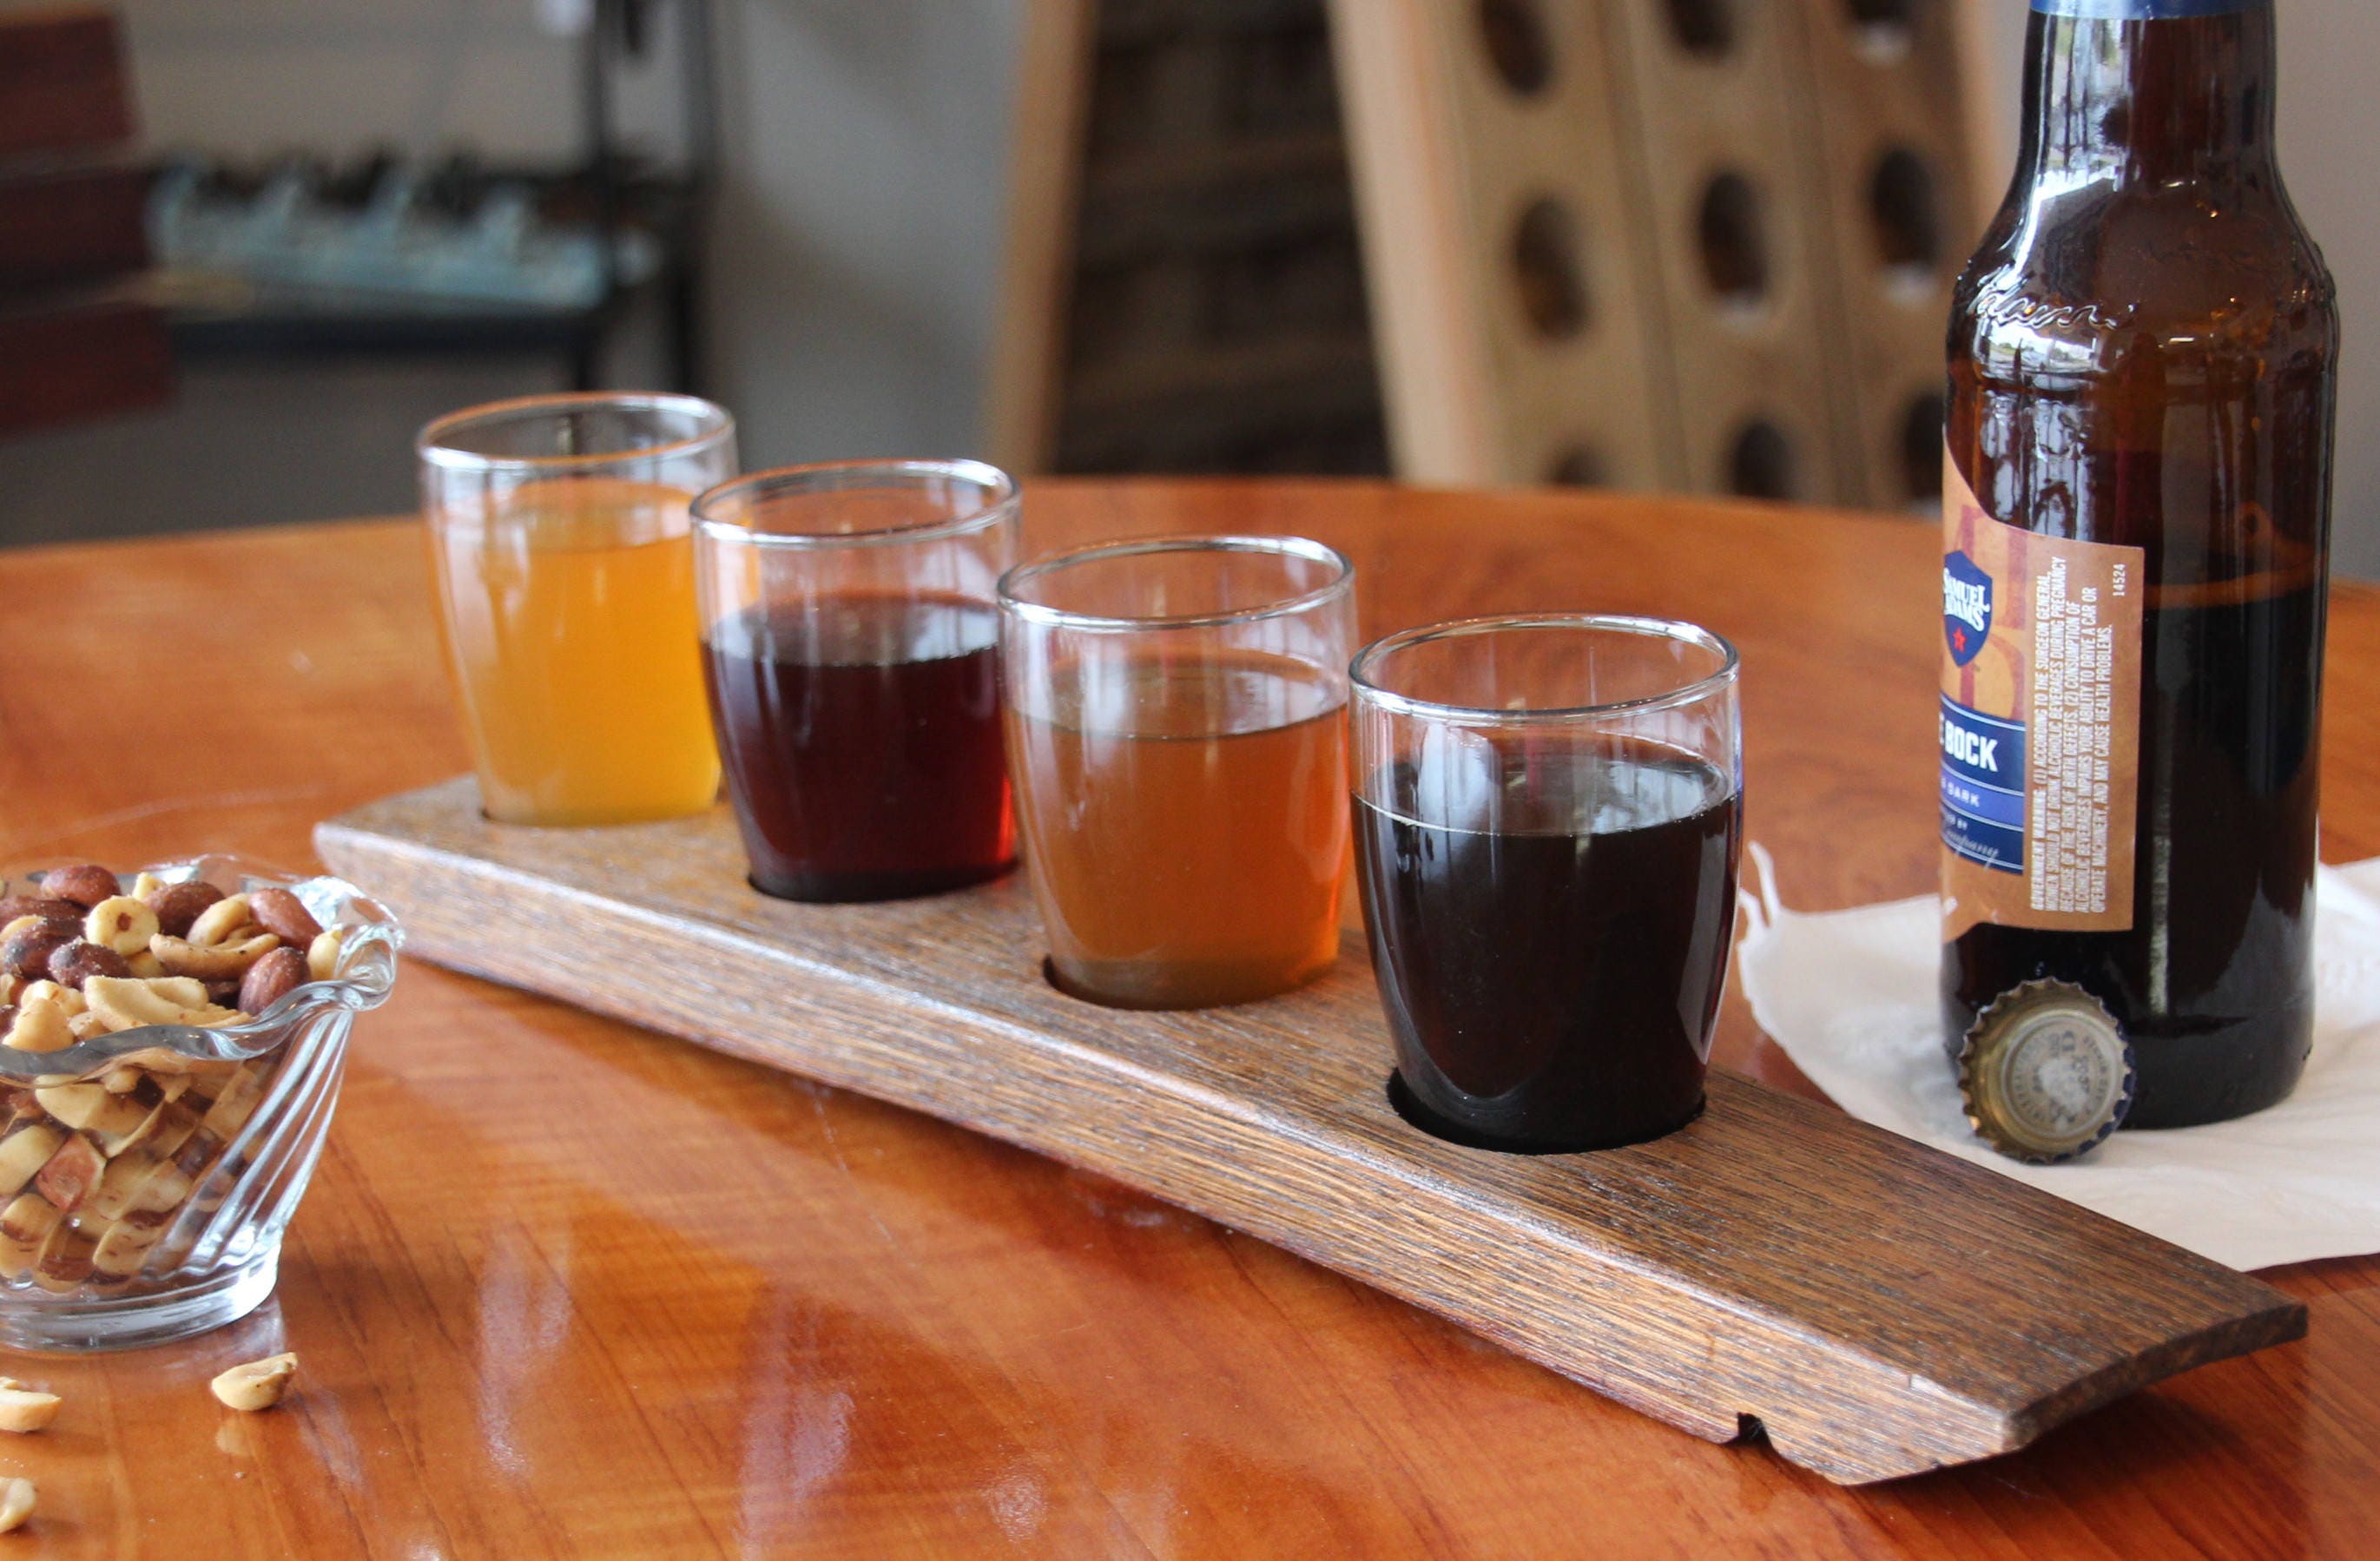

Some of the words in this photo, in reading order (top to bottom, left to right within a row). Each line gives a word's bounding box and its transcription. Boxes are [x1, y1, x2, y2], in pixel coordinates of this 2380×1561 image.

[2051, 557, 2067, 618] PREGNANCY
[2113, 563, 2126, 596] 14524
[2067, 601, 2080, 615] OF
[2082, 587, 2098, 603] OR
[2081, 605, 2097, 626] CAR
[2035, 622, 2050, 669] SURGEON
[2050, 620, 2064, 659] DURING
[2066, 616, 2080, 689] CONSUMPTION
[2080, 638, 2095, 669] DRIVE
[2035, 672, 2048, 690] THE
[2049, 661, 2063, 720] BEVERAGES
[2080, 671, 2094, 683] TO
[2034, 693, 2047, 706] TO
[2066, 691, 2078, 707] (2)
[2080, 686, 2094, 724] ABILITY
[2096, 683, 2111, 721] HEALTH
[1944, 720, 1998, 773] BOCK
[2034, 708, 2048, 767] ACCORDING
[2047, 721, 2062, 778] ALCOHOLIC
[2078, 725, 2093, 753] YOUR
[2094, 724, 2110, 757] CAUSE
[2063, 757, 2077, 787] BIRTH
[2077, 755, 2092, 796] IMPAIRS
[2094, 760, 2108, 781] MAY
[1948, 780, 1980, 807] DARK
[2047, 779, 2060, 809] DRINK
[2062, 789, 2076, 803] OF
[2093, 783, 2108, 804] AND
[2047, 811, 2060, 832] NOT
[2062, 805, 2076, 828] RISK
[2076, 798, 2092, 856] BEVERAGES
[2061, 831, 2075, 849] THE
[2091, 868, 2106, 912] OPERATE
